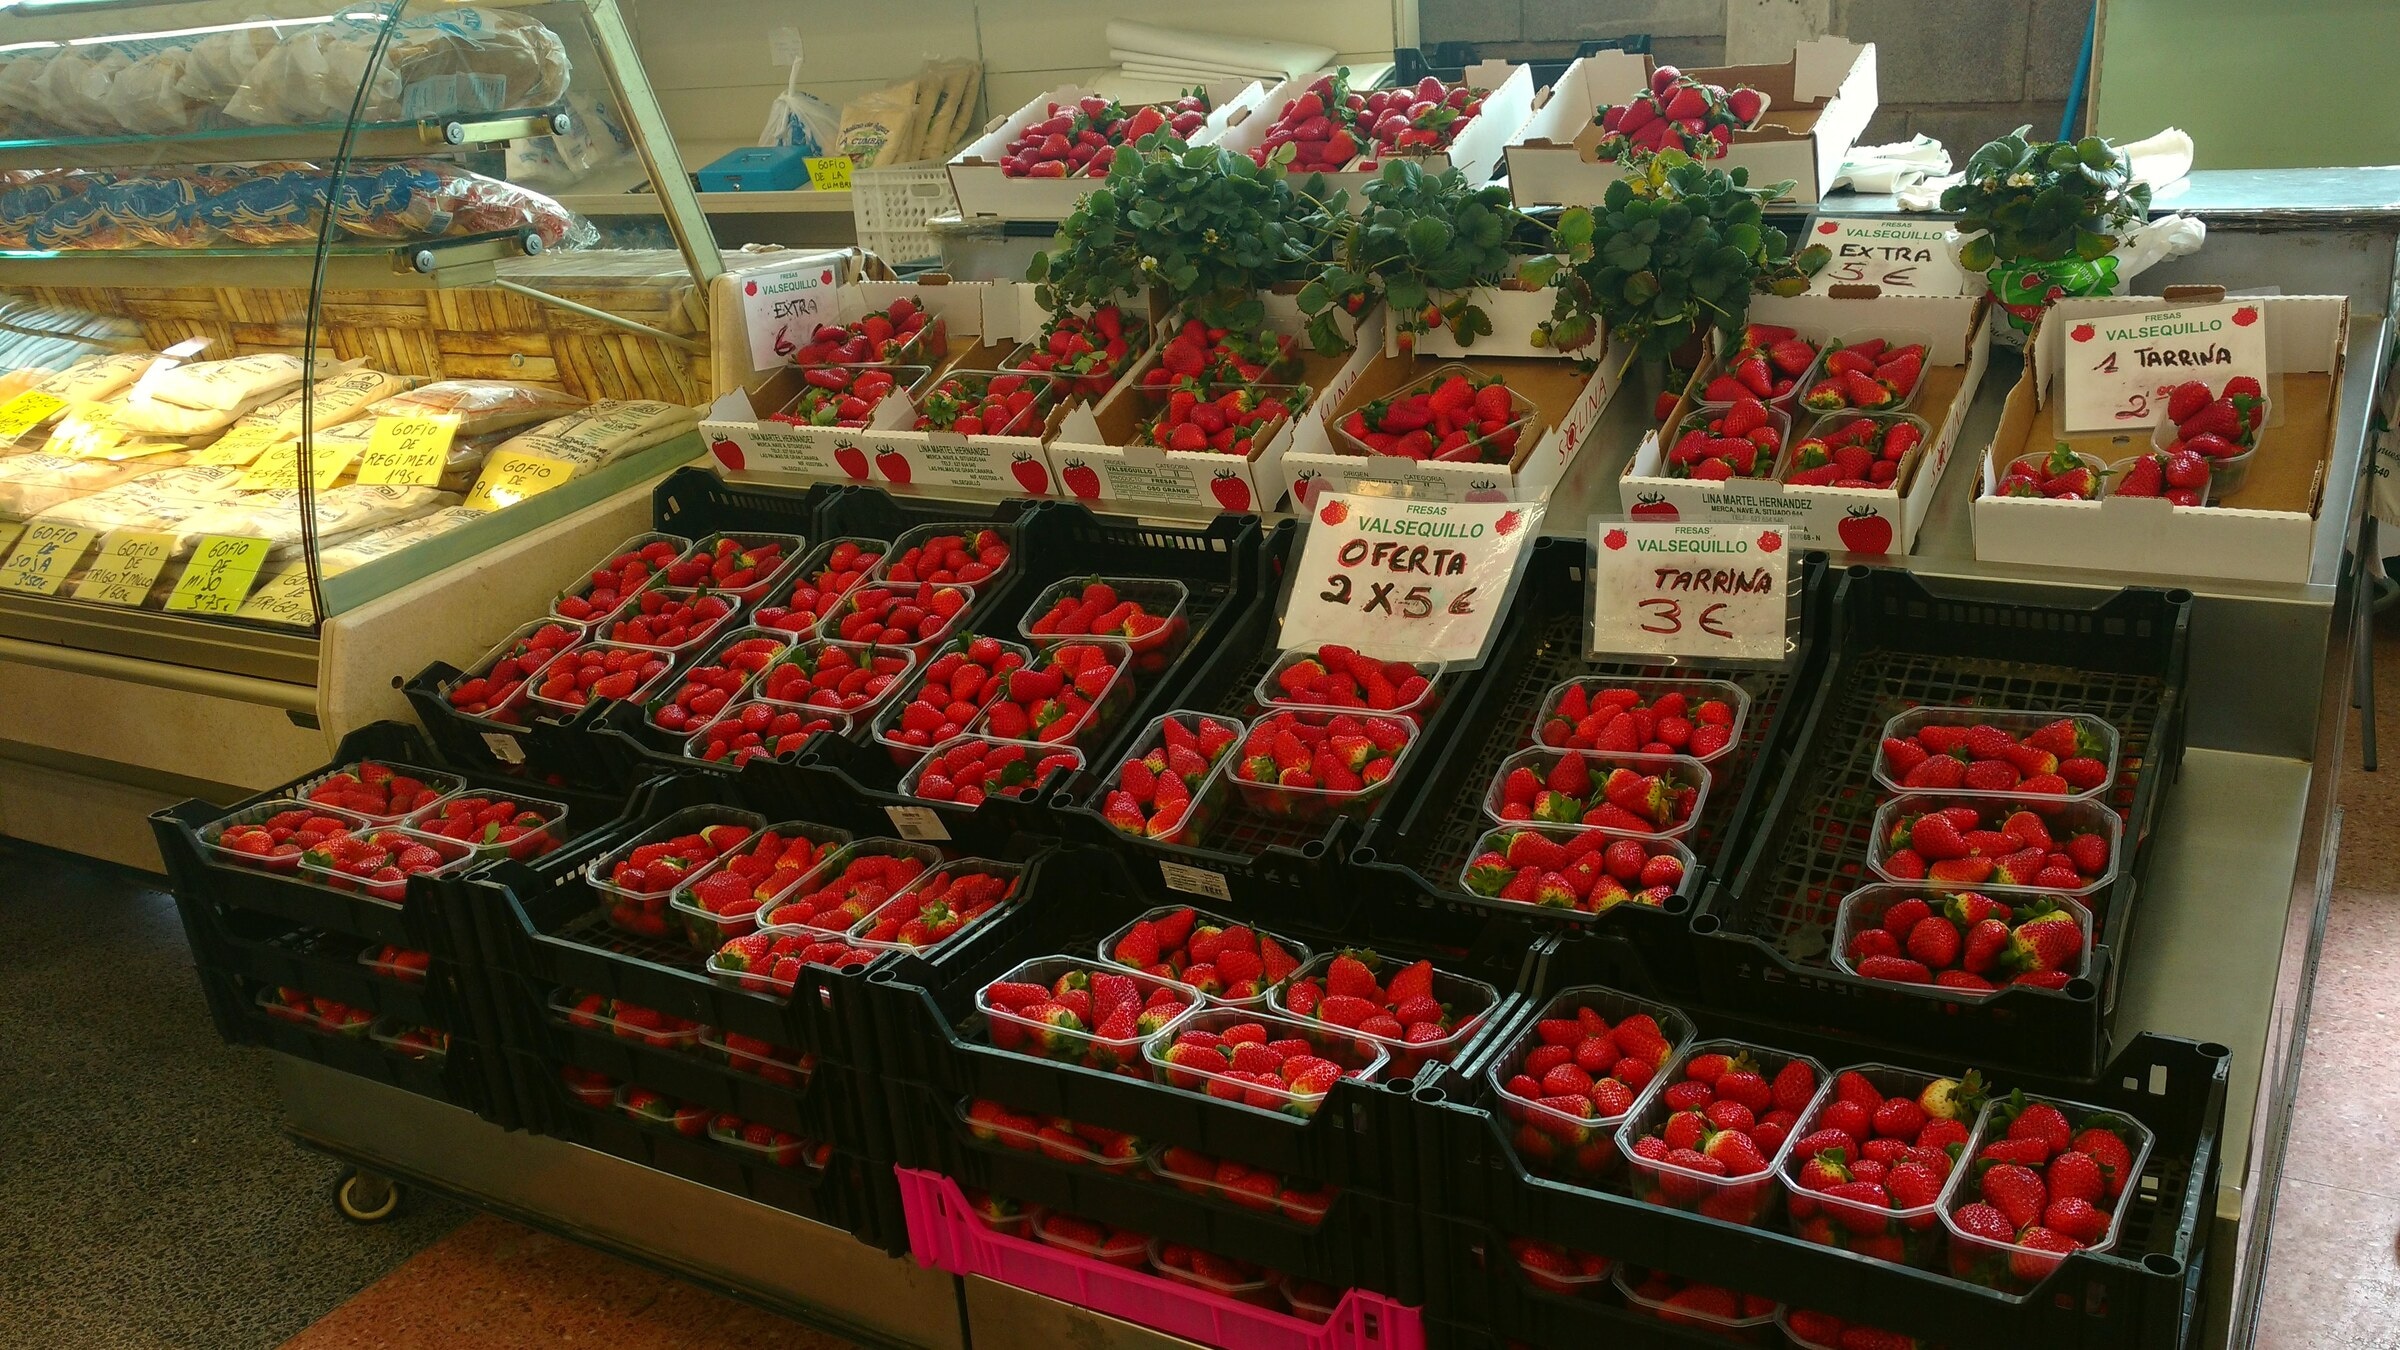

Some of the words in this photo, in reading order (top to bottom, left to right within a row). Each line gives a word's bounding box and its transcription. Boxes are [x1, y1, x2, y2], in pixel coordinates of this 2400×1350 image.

[815, 173, 825, 181] DE
[833, 171, 843, 180] LA
[1847, 228, 1943, 241] VALSEQUILLO
[780, 272, 798, 280] FRESAS
[1828, 262, 1867, 281] 5
[1882, 266, 1918, 288] €
[762, 278, 818, 295] VALSEQUILLO
[773, 299, 818, 319] EXTRA
[2145, 311, 2181, 322] FRESAS
[2106, 319, 2222, 341] VALSEQUILLO
[773, 323, 797, 356] 6
[2091, 351, 2120, 373] 1
[399, 438, 420, 450] DE
[1107, 466, 1153, 474] VALSEQUILLO
[507, 475, 527, 486] DE
[1702, 493, 1721, 504] LINA
[1723, 494, 1758, 507] MARTEL
[1759, 497, 1812, 510] HERNANDEZ
[1407, 504, 1448, 516] FRESAS
[1358, 516, 1485, 538] VALSEQUILLO
[1674, 527, 1710, 535] FRESAS
[38, 541, 60, 555] DE
[1637, 539, 1748, 554] VALSEQUILLO
[124, 558, 143, 570] DE
[1337, 538, 1467, 577] OFERTA
[211, 559, 232, 574] DE
[86, 568, 116, 583] TRIGO
[1320, 573, 1352, 605] 2
[1403, 586, 1433, 618] 5
[251, 595, 299, 613] TRIGO
[1638, 598, 1683, 635] 3
[1699, 602, 1734, 639] €
